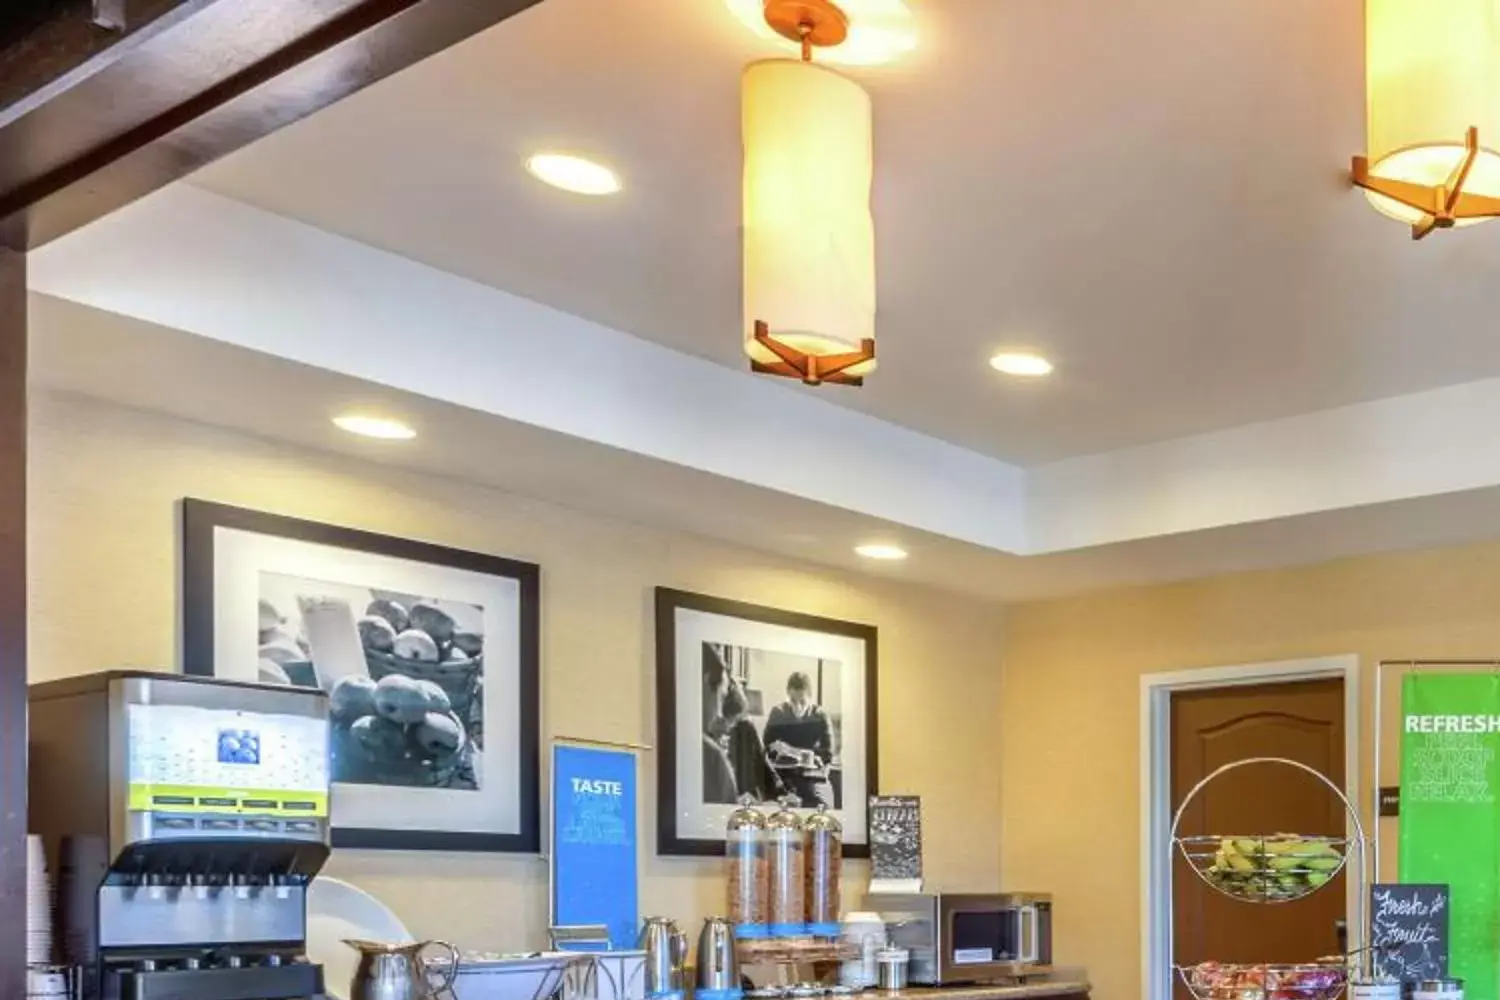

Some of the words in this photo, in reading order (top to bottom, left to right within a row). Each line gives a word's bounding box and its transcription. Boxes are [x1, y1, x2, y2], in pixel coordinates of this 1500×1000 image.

[570, 777, 624, 796] TASTE
[1374, 890, 1429, 917] Fresh
[1374, 919, 1440, 945] Fruit
